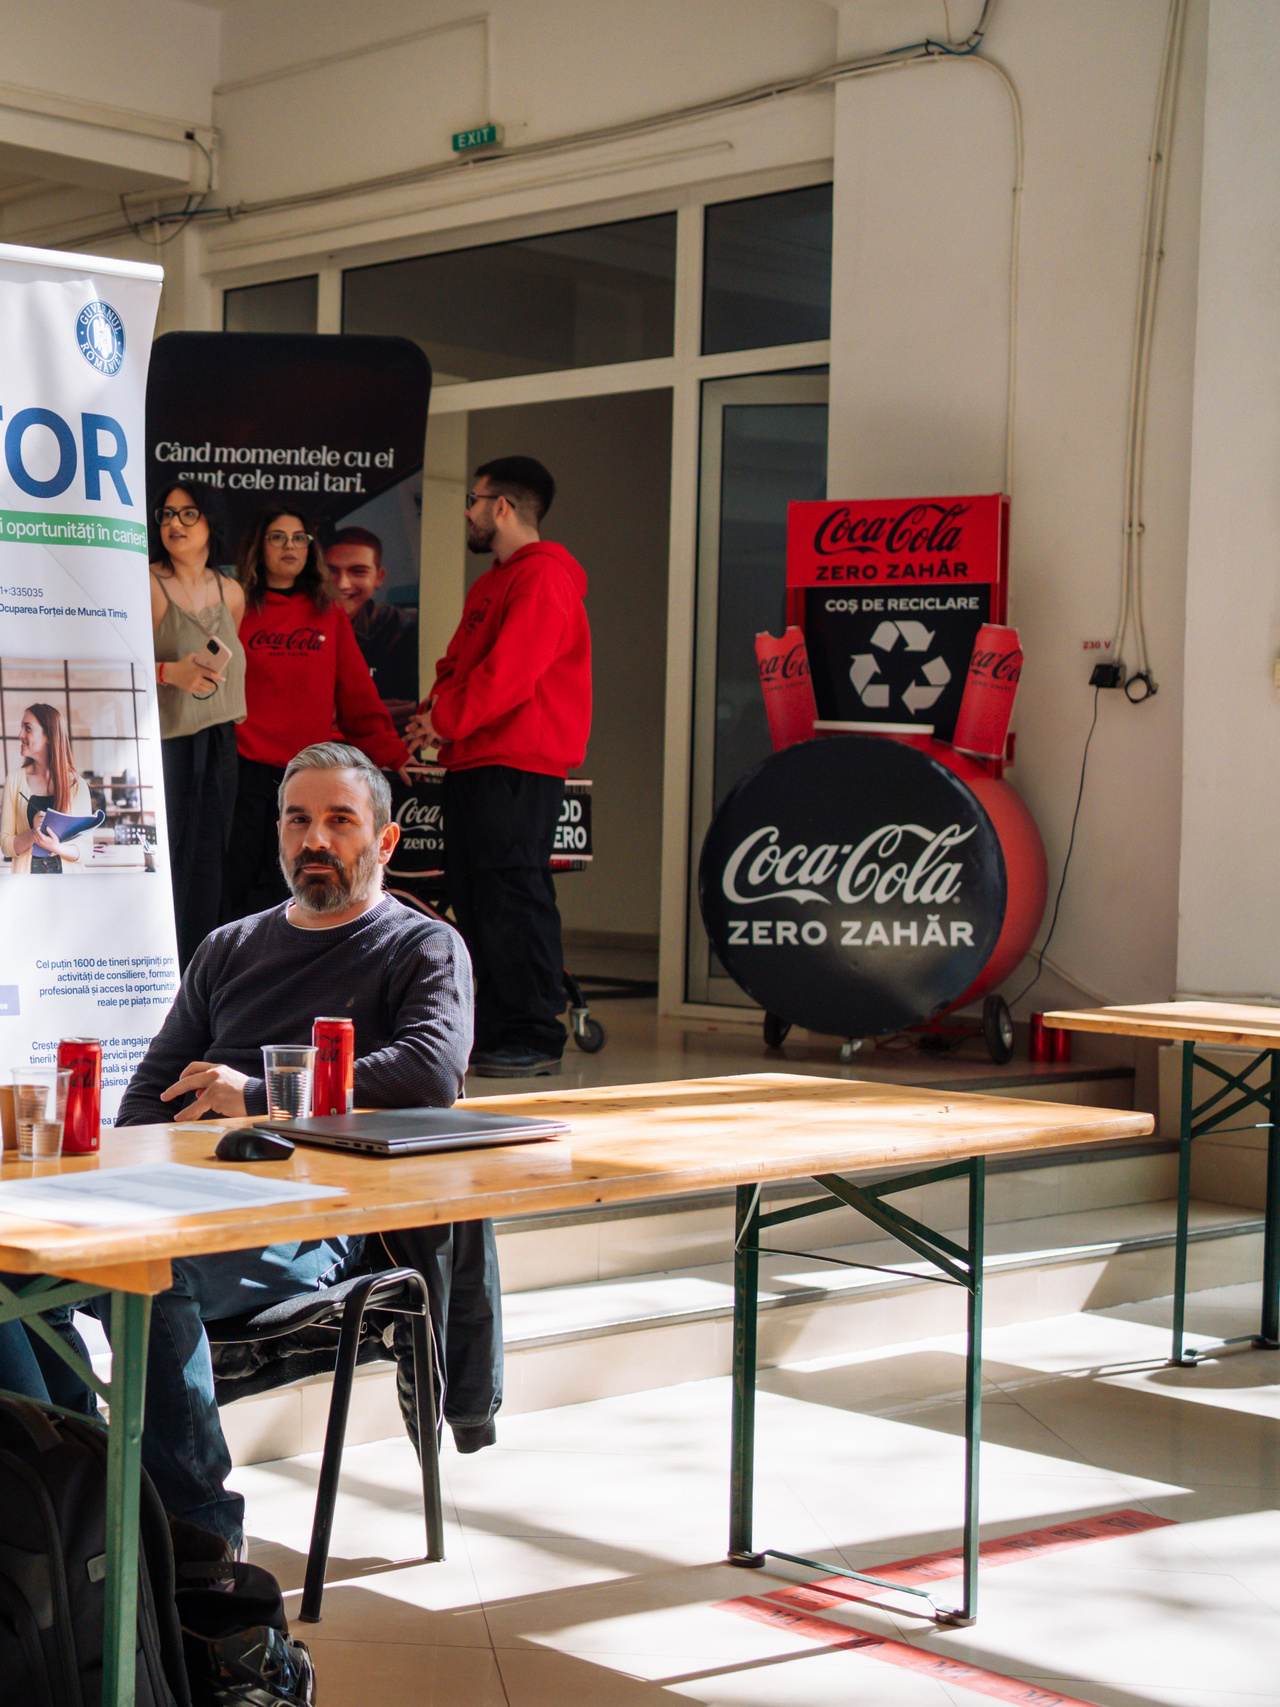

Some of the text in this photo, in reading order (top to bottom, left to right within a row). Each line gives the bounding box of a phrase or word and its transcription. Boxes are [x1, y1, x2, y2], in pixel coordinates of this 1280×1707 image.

[458, 128, 489, 147] EXIT
[80, 302, 122, 334] GUVERNUL
[155, 441, 394, 468] Când momentele cu ei
[228, 469, 275, 490] cele
[278, 471, 319, 492] mai
[323, 472, 366, 493] tari.
[6, 521, 95, 544] oportunități
[97, 524, 110, 541] în
[112, 528, 147, 548] carieră
[813, 503, 973, 555] Coca-Cola
[815, 559, 969, 581] ZERO ZAHĂR
[39, 605, 64, 618] Forței
[65, 606, 77, 616] de
[77, 607, 107, 618] Muncă
[107, 608, 128, 621] Timiș
[825, 596, 980, 615] COȘ DE RECICLARE
[248, 628, 326, 651] Coca-Cola
[1083, 640, 1112, 650] 230 V
[403, 837, 437, 850] zero
[722, 823, 978, 905] Coca-Cola
[727, 914, 975, 947] ZERO ZAHĂR
[36, 959, 50, 969] Cel
[51, 958, 72, 971] puțin
[73, 958, 95, 968] 1600
[96, 957, 108, 967] de
[108, 957, 130, 967] tineri
[131, 955, 162, 968] sprijiniți
[57, 971, 93, 983] activități
[94, 971, 105, 981] de
[106, 969, 148, 981] consiliere,
[39, 985, 90, 998] profesională
[91, 984, 99, 996] și
[99, 984, 124, 993] acces
[125, 983, 133, 992] la
[97, 997, 118, 1007] reale
[119, 998, 130, 1008] pe
[130, 996, 152, 1008] piața
[109, 1037, 120, 1047] de
[121, 1036, 152, 1047] angajar
[29, 1053, 52, 1064] tinerii
[121, 1063, 128, 1074] și
[101, 1077, 128, 1089] găsirea
